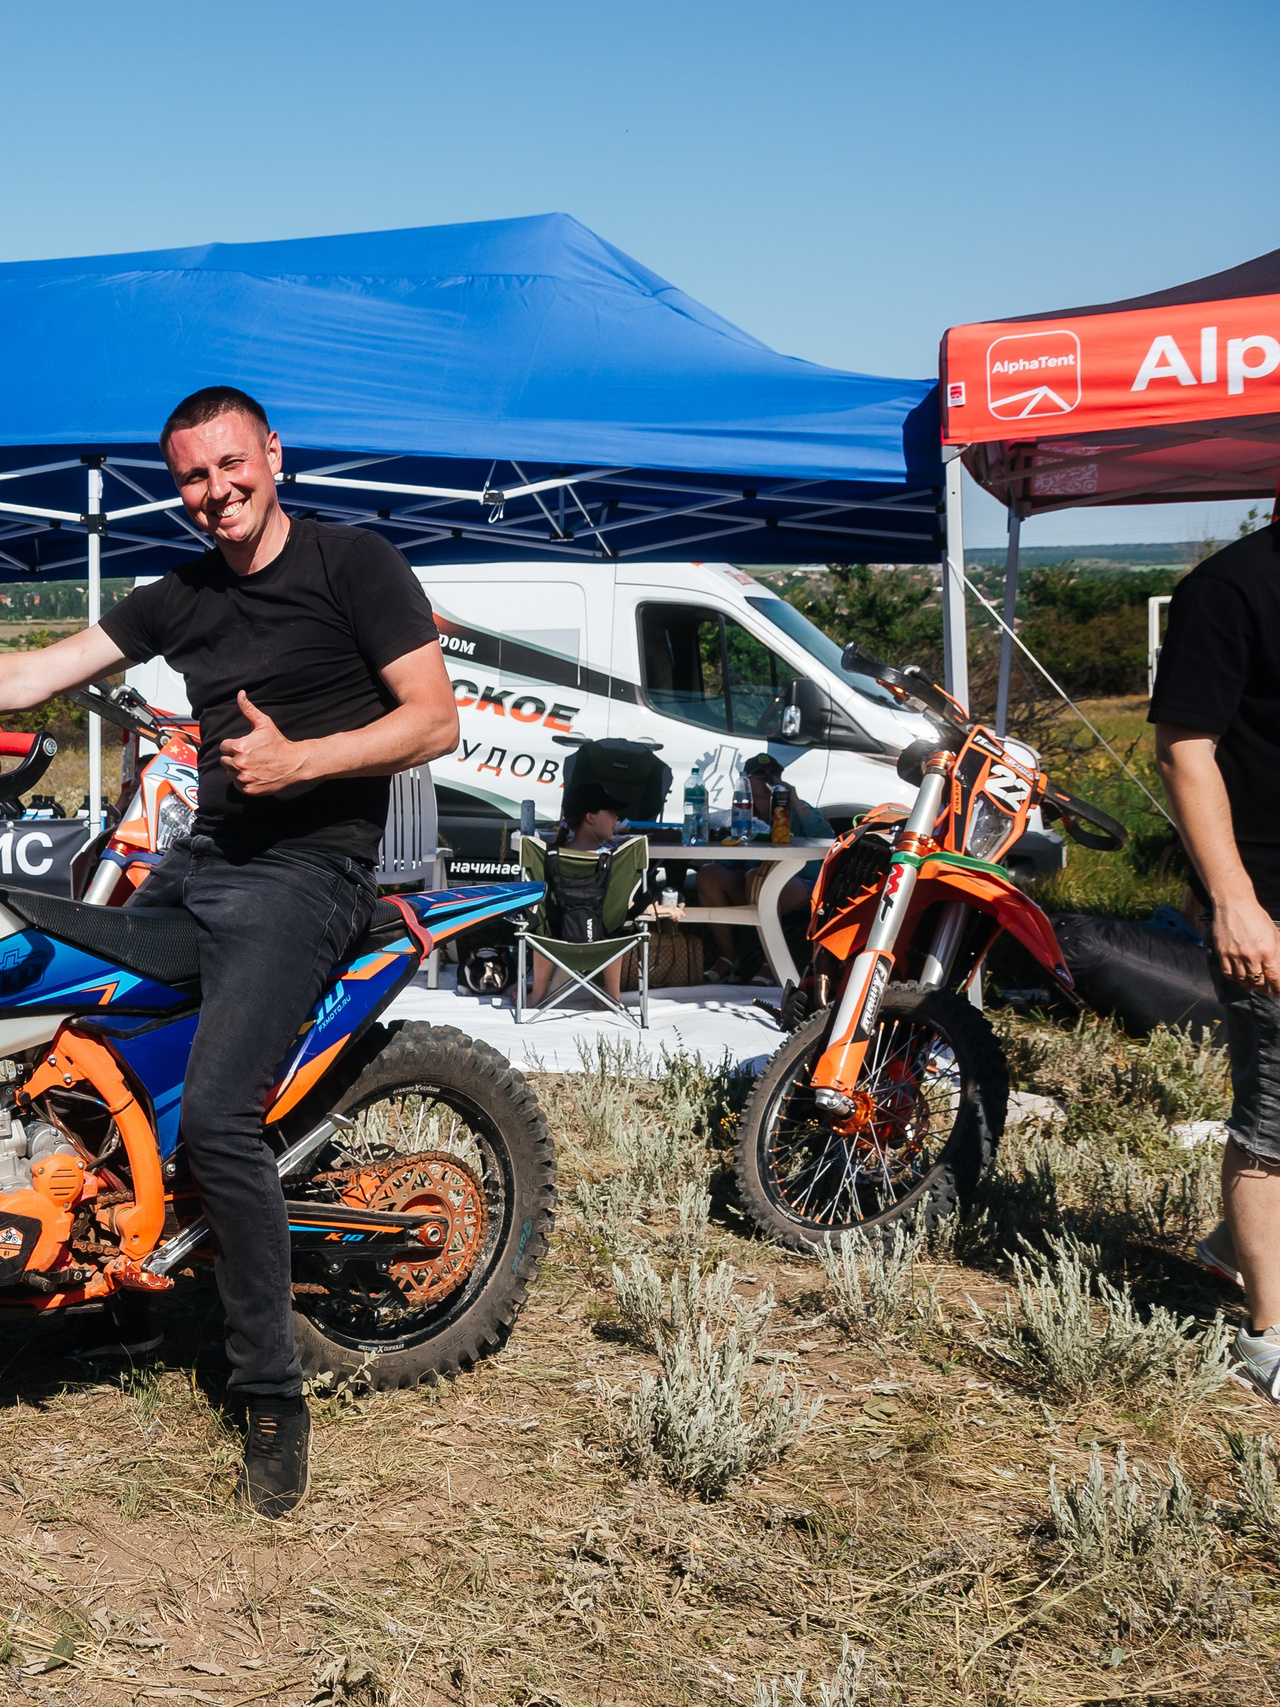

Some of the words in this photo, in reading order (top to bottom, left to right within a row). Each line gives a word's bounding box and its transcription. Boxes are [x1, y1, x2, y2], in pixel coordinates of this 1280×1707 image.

[991, 353, 1076, 375] AlphaTent
[451, 678, 581, 734] СКОЕ
[457, 738, 566, 789] УДОВ
[984, 764, 1033, 813] 22
[318, 994, 352, 1033] FXMOTO.RU
[323, 1232, 366, 1242] K10
